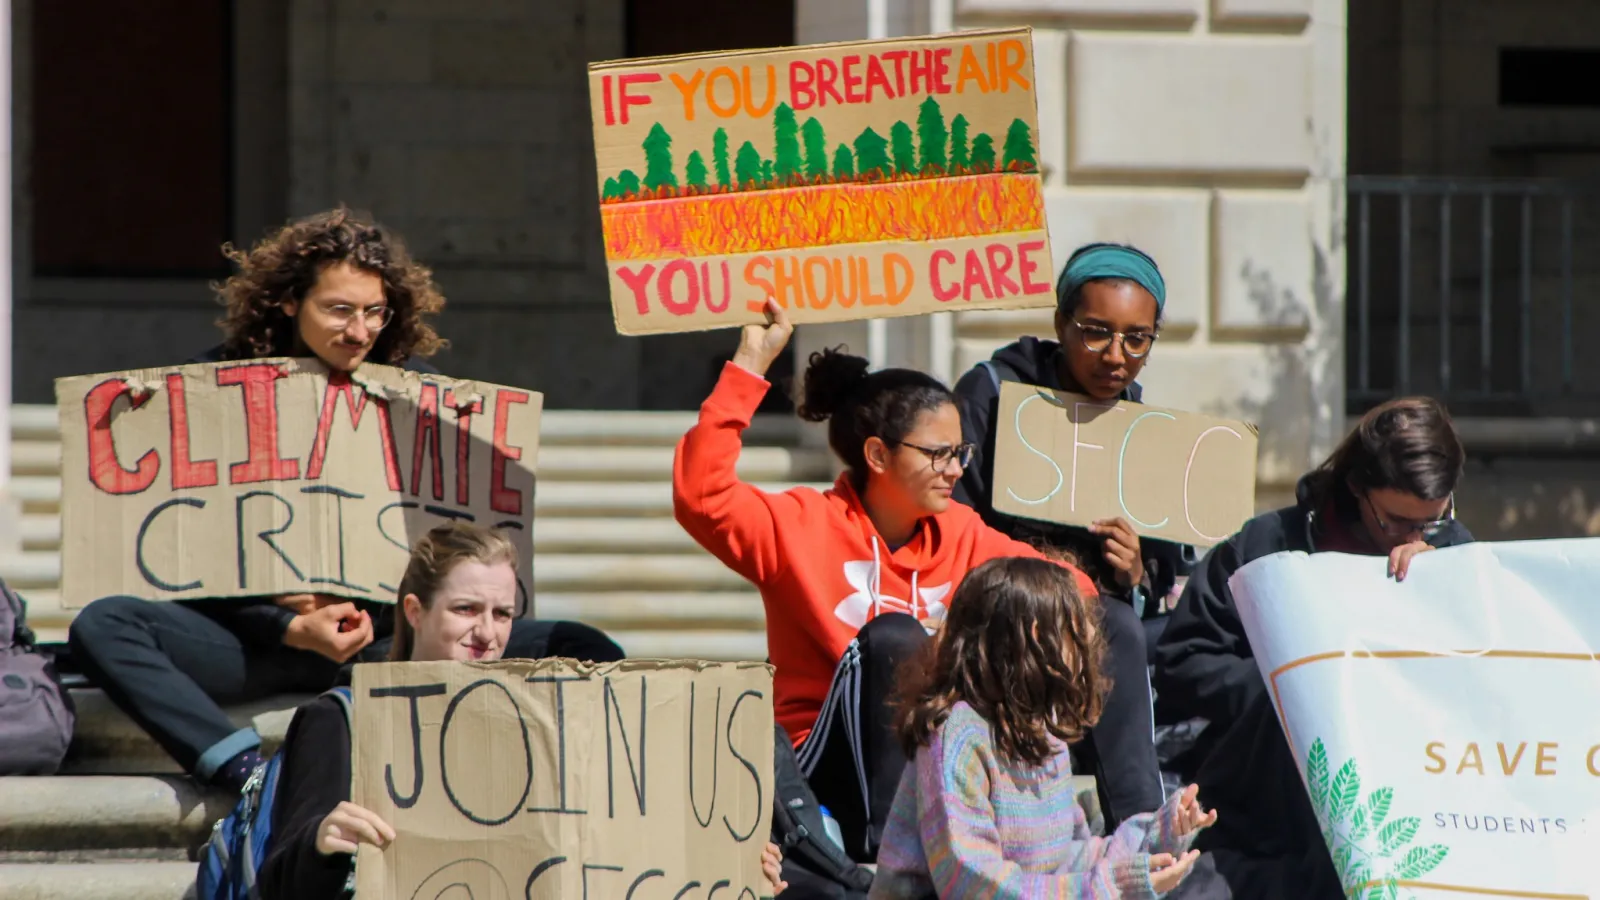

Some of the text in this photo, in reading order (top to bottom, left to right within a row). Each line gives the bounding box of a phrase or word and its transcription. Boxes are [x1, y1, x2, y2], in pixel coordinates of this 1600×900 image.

[602, 39, 1030, 126] IF YOU BREATHE AIR
[616, 240, 1051, 315] YOU SHOULD CARE
[84, 362, 530, 515] CLIMATE
[1007, 392, 1242, 542] SFCC
[369, 675, 763, 842] JOIN US
[1424, 741, 1559, 776] SAVE
[1434, 811, 1567, 835] STUDENTS
